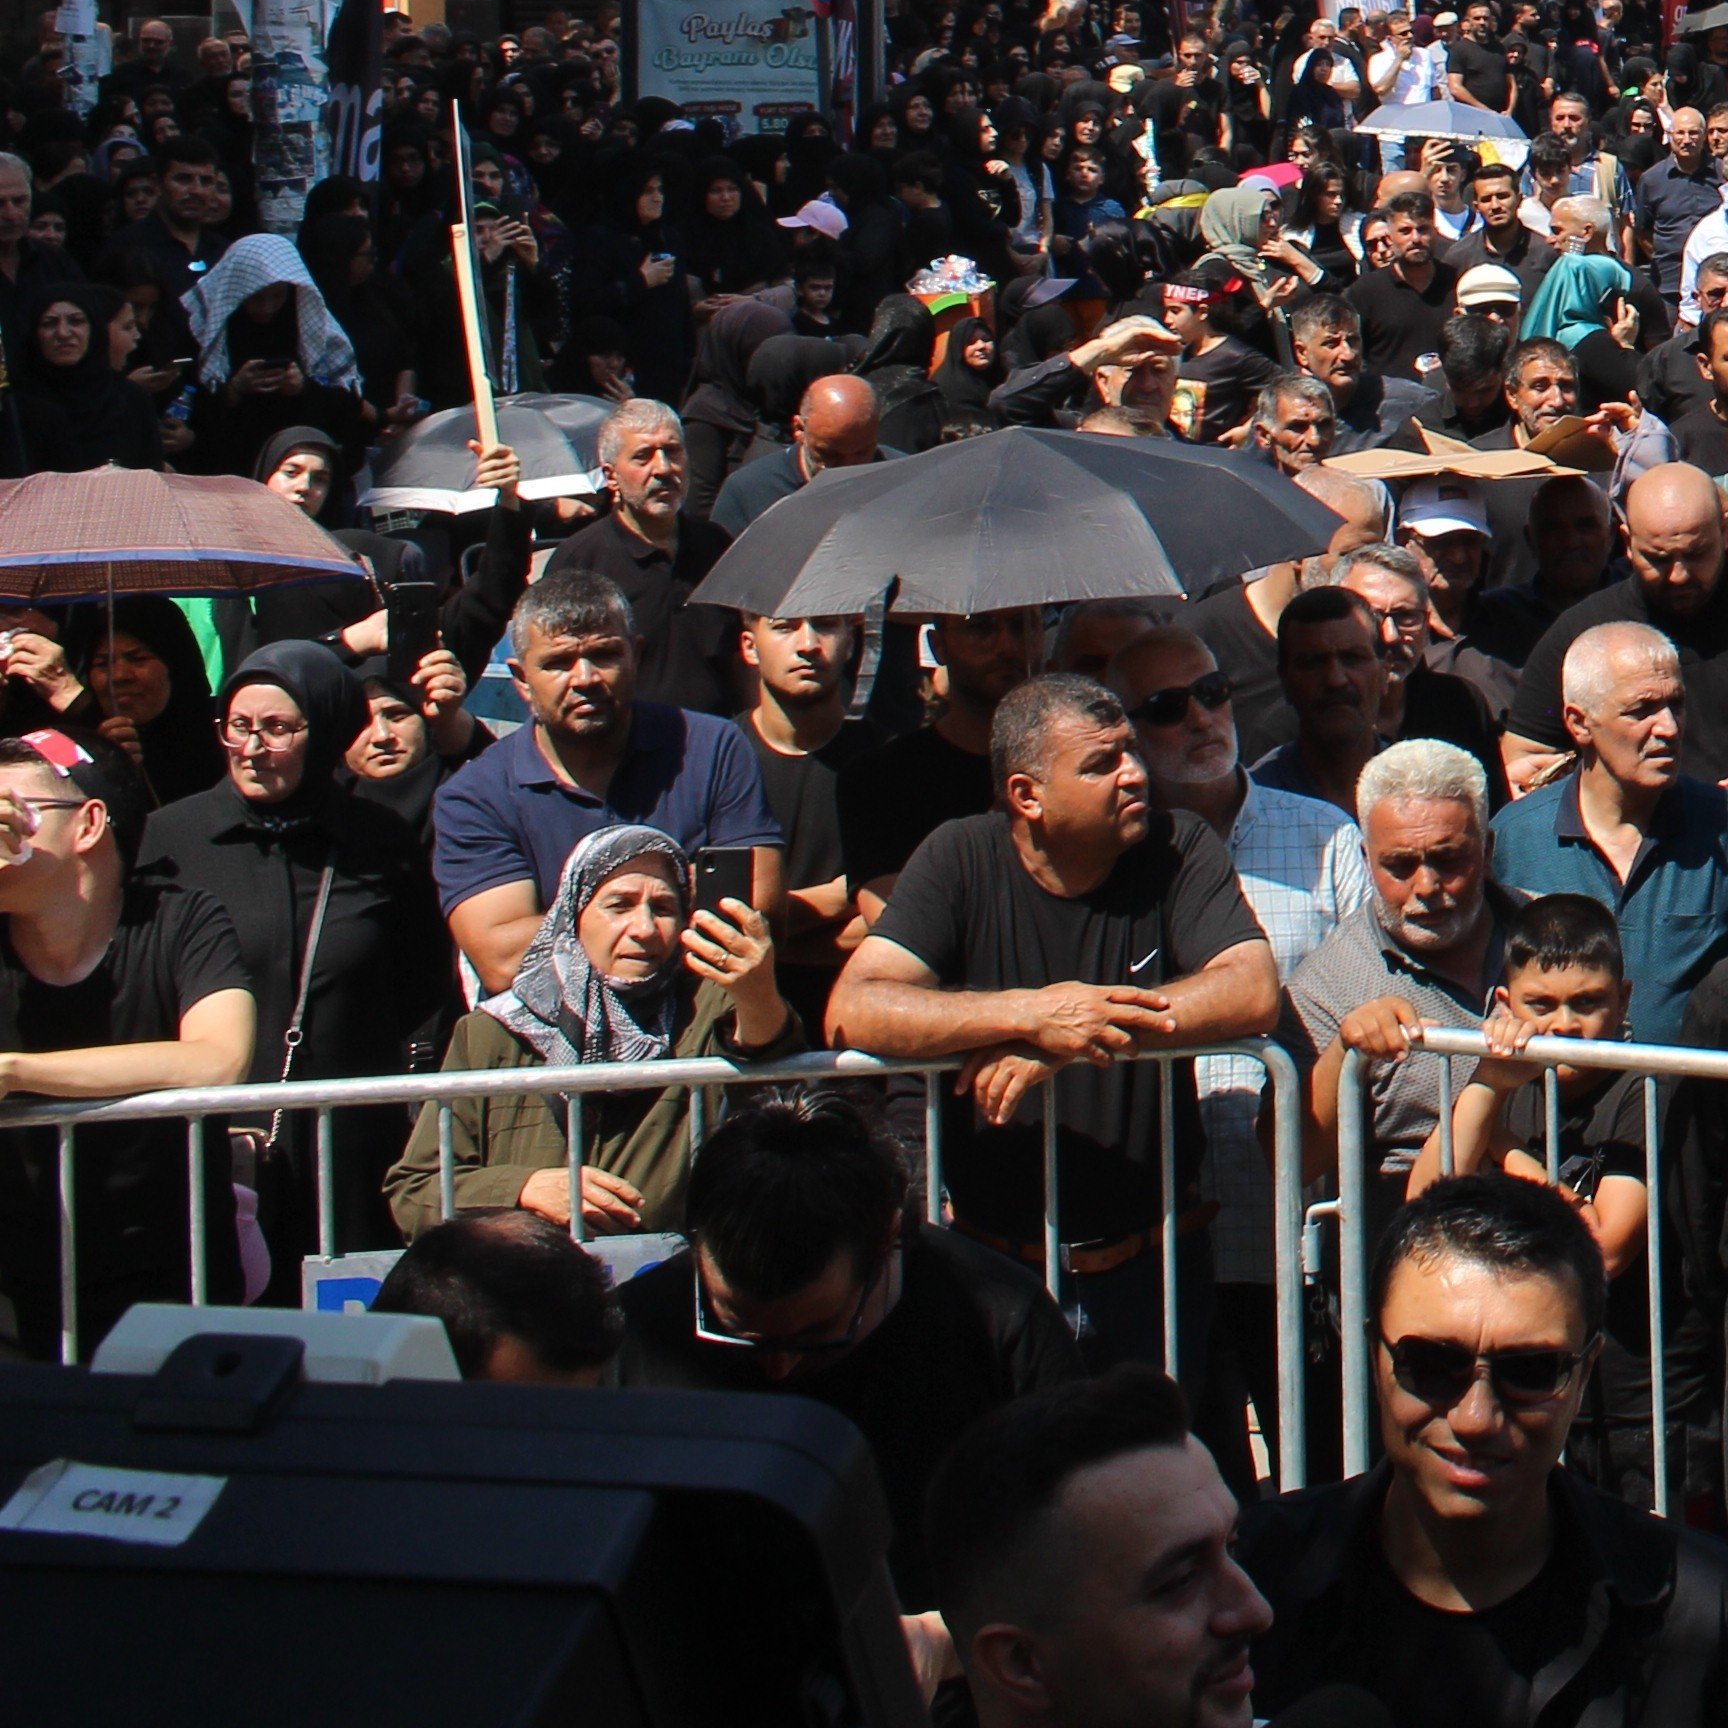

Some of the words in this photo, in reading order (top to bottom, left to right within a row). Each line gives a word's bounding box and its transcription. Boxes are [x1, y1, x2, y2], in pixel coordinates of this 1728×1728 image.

[678, 11, 774, 44] Paylaş
[1164, 283, 1210, 302] YNEP
[73, 1488, 156, 1514] CAM
[155, 1494, 183, 1519] 2
